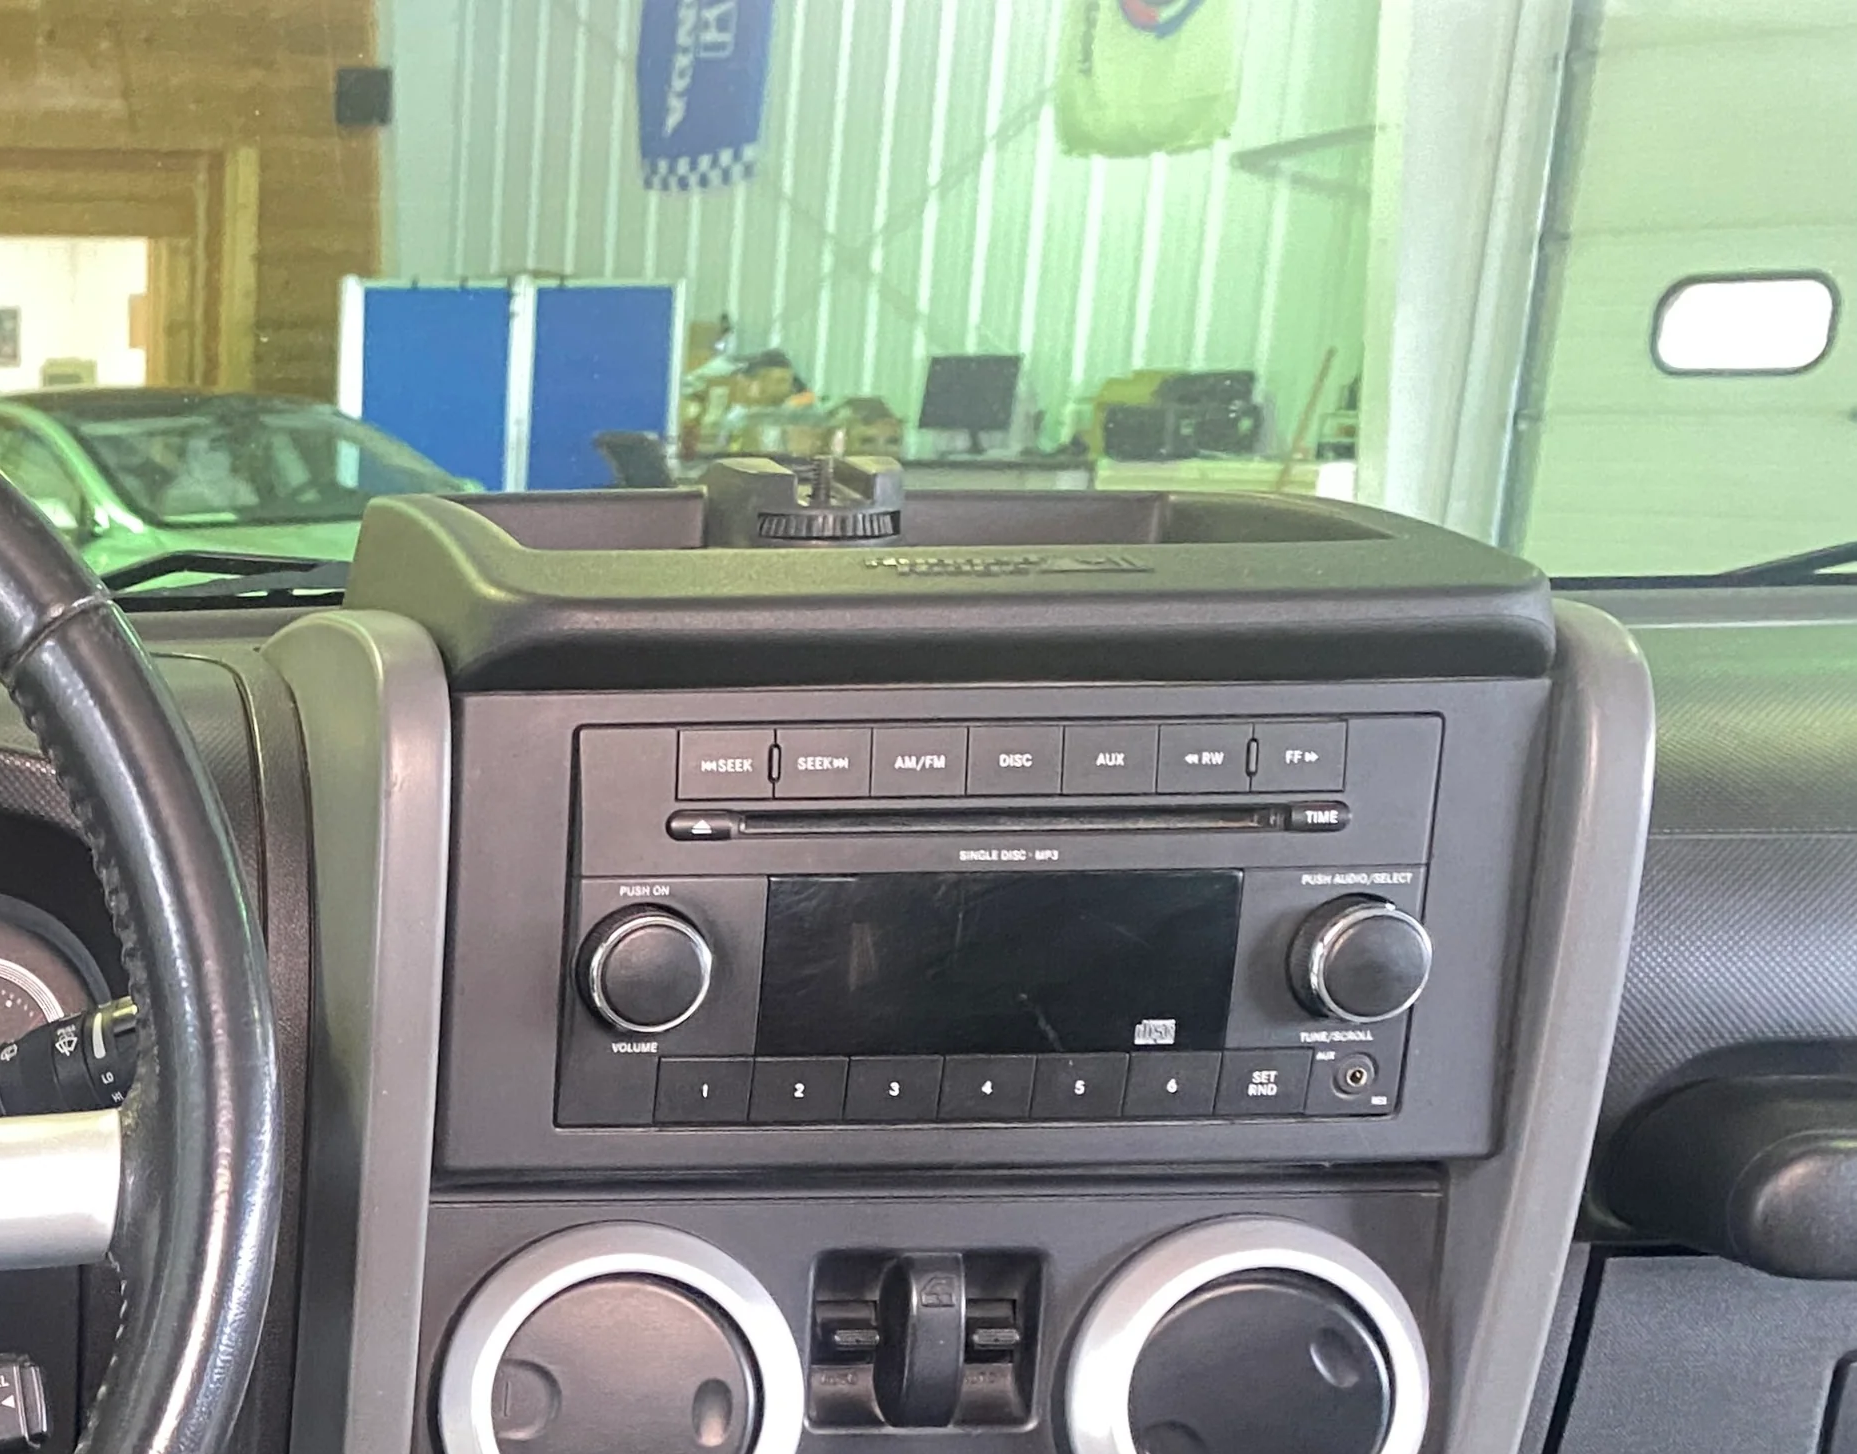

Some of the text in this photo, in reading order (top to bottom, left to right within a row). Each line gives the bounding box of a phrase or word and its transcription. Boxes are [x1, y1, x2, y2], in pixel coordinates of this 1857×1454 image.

[797, 757, 833, 770] SEEK
[894, 756, 946, 770] AM/FM
[999, 753, 1033, 768] DISC
[1096, 752, 1125, 767] AUX
[1201, 751, 1224, 765] RW
[1285, 750, 1302, 764] FF
[718, 758, 753, 772] SEEK
[1305, 810, 1339, 824] TIME
[1000, 849, 1027, 861] DISC
[619, 885, 670, 897] PUSH ON
[611, 1042, 658, 1053] VOLUME
[1252, 1071, 1278, 1083] SET
[701, 1083, 710, 1098] 1
[794, 1083, 806, 1098] 2
[888, 1081, 901, 1097] 3
[980, 1080, 993, 1095] 4
[1074, 1079, 1086, 1095] 5
[1166, 1079, 1178, 1094] 6
[1248, 1084, 1278, 1096] RND
